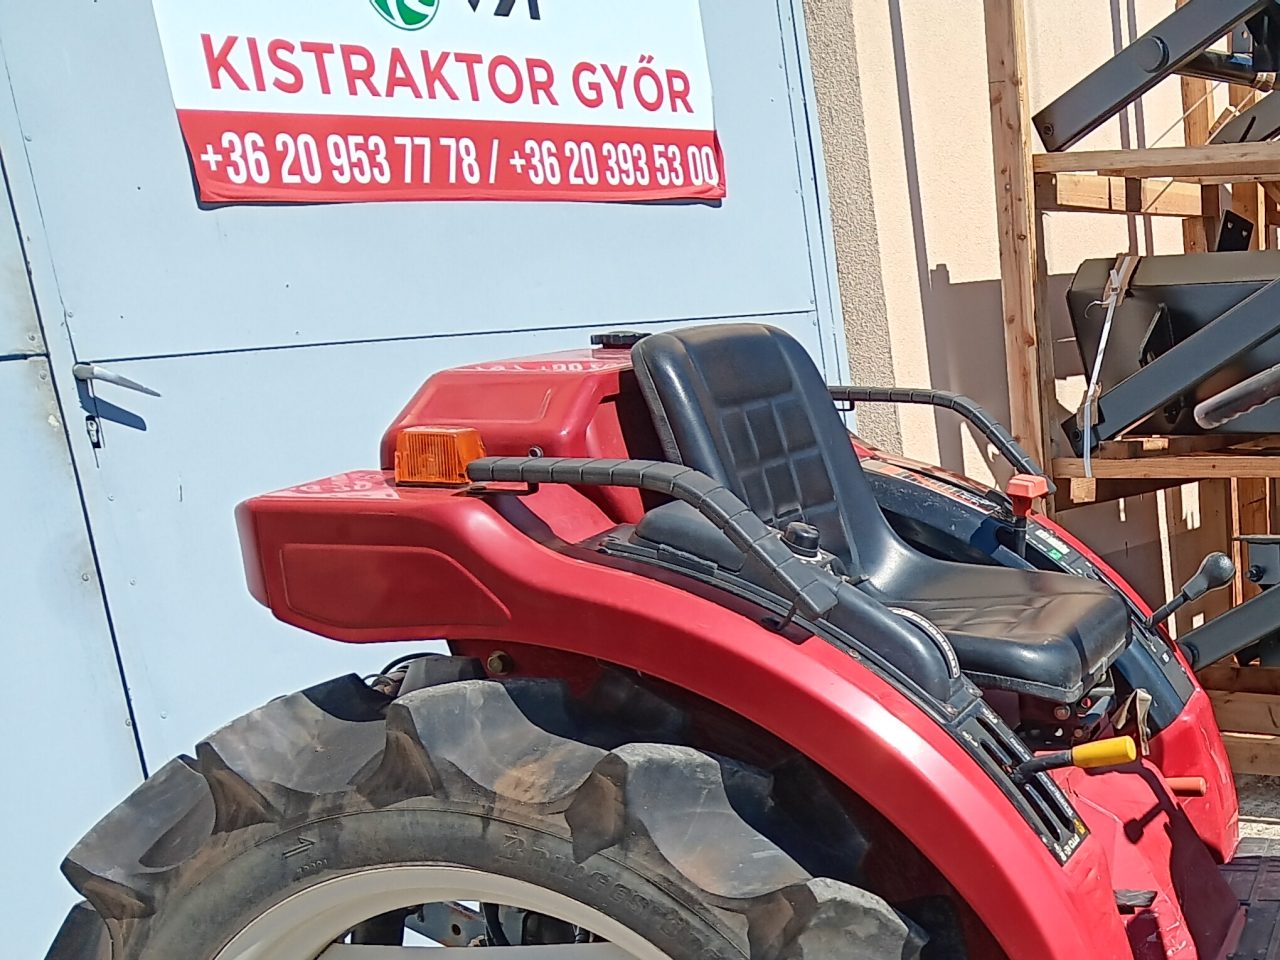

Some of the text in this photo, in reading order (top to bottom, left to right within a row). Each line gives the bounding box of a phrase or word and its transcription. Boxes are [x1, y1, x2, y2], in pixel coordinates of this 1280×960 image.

[201, 34, 693, 113] KISTRAKTOR GYŐR
[200, 131, 271, 185] +36
[275, 132, 323, 185] 20
[326, 134, 391, 185] 953
[393, 136, 431, 184] 77
[439, 137, 481, 185] 78
[509, 139, 561, 185] +36
[564, 140, 599, 186] 20
[602, 142, 650, 186] 393
[652, 144, 685, 187] 53
[686, 145, 720, 189] 00
